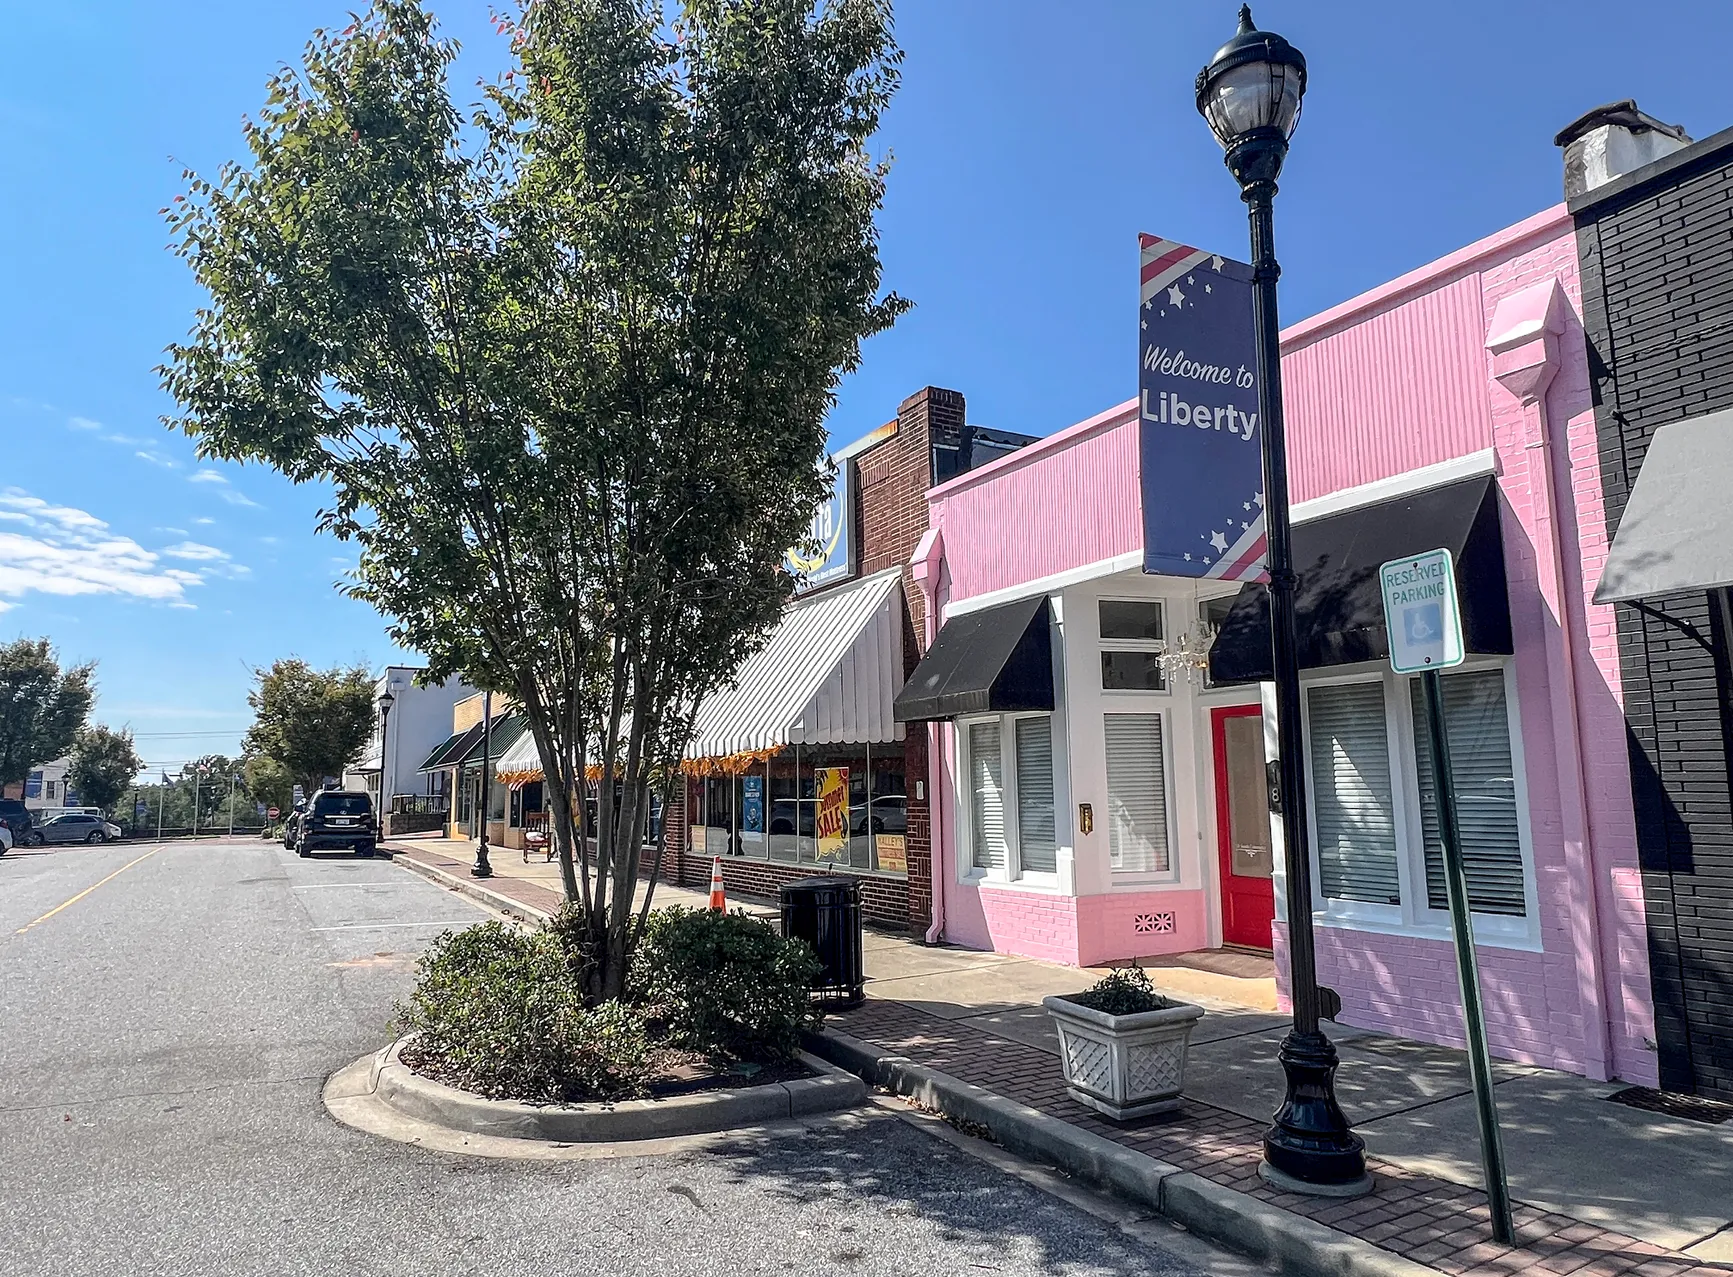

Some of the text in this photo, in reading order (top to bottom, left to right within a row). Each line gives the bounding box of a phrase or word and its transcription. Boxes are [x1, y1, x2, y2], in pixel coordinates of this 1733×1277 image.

[1143, 343, 1254, 389] Welcome to
[1142, 389, 1258, 441] Liberty
[1386, 563, 1446, 588] RESERVED
[1392, 582, 1445, 605] PARKING
[817, 806, 842, 839] SALE
